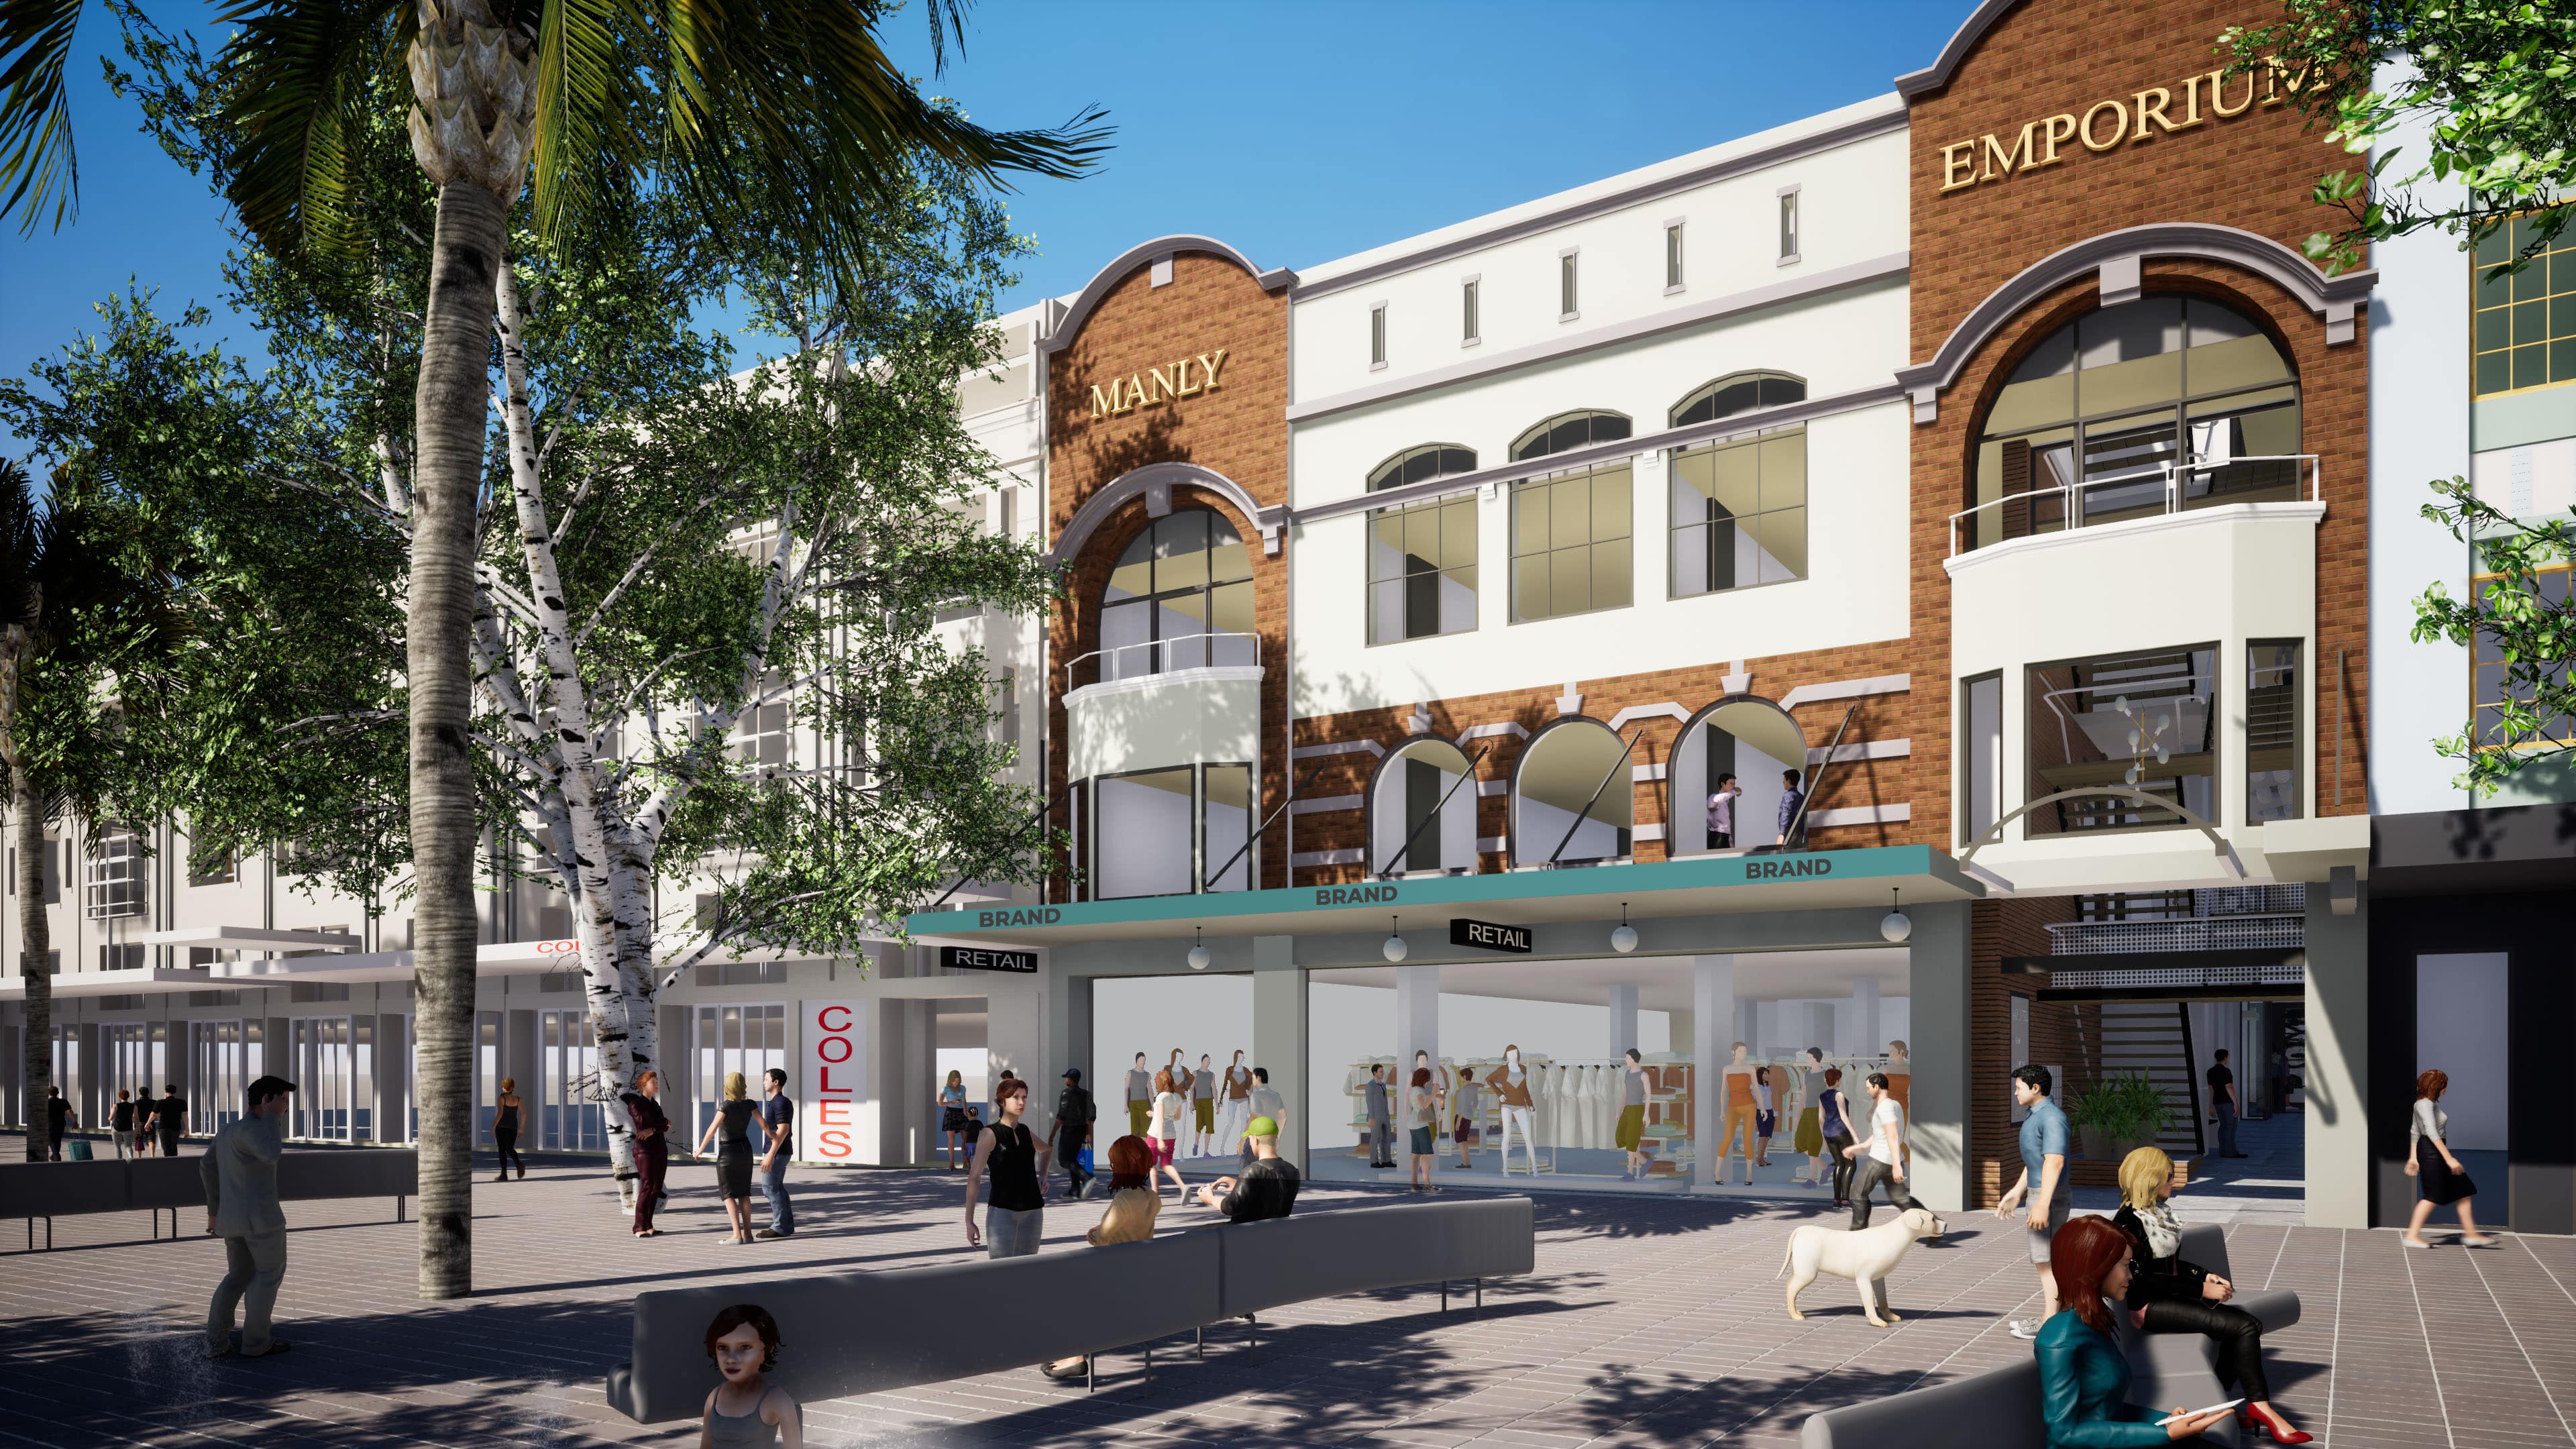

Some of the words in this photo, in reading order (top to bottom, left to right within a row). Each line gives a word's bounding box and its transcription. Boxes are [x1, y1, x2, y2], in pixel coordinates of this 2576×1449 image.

[1939, 54, 2330, 193] EMPORIUM
[1090, 348, 1228, 419] MANLY
[1746, 859, 1831, 879] BRAND
[1316, 885, 1397, 906] BRAND
[979, 908, 1061, 927] BRAND
[1468, 923, 1529, 949] RETAIL
[537, 941, 580, 953] COL
[956, 950, 1033, 969] RETAIL
[818, 1006, 853, 1157] COLES
